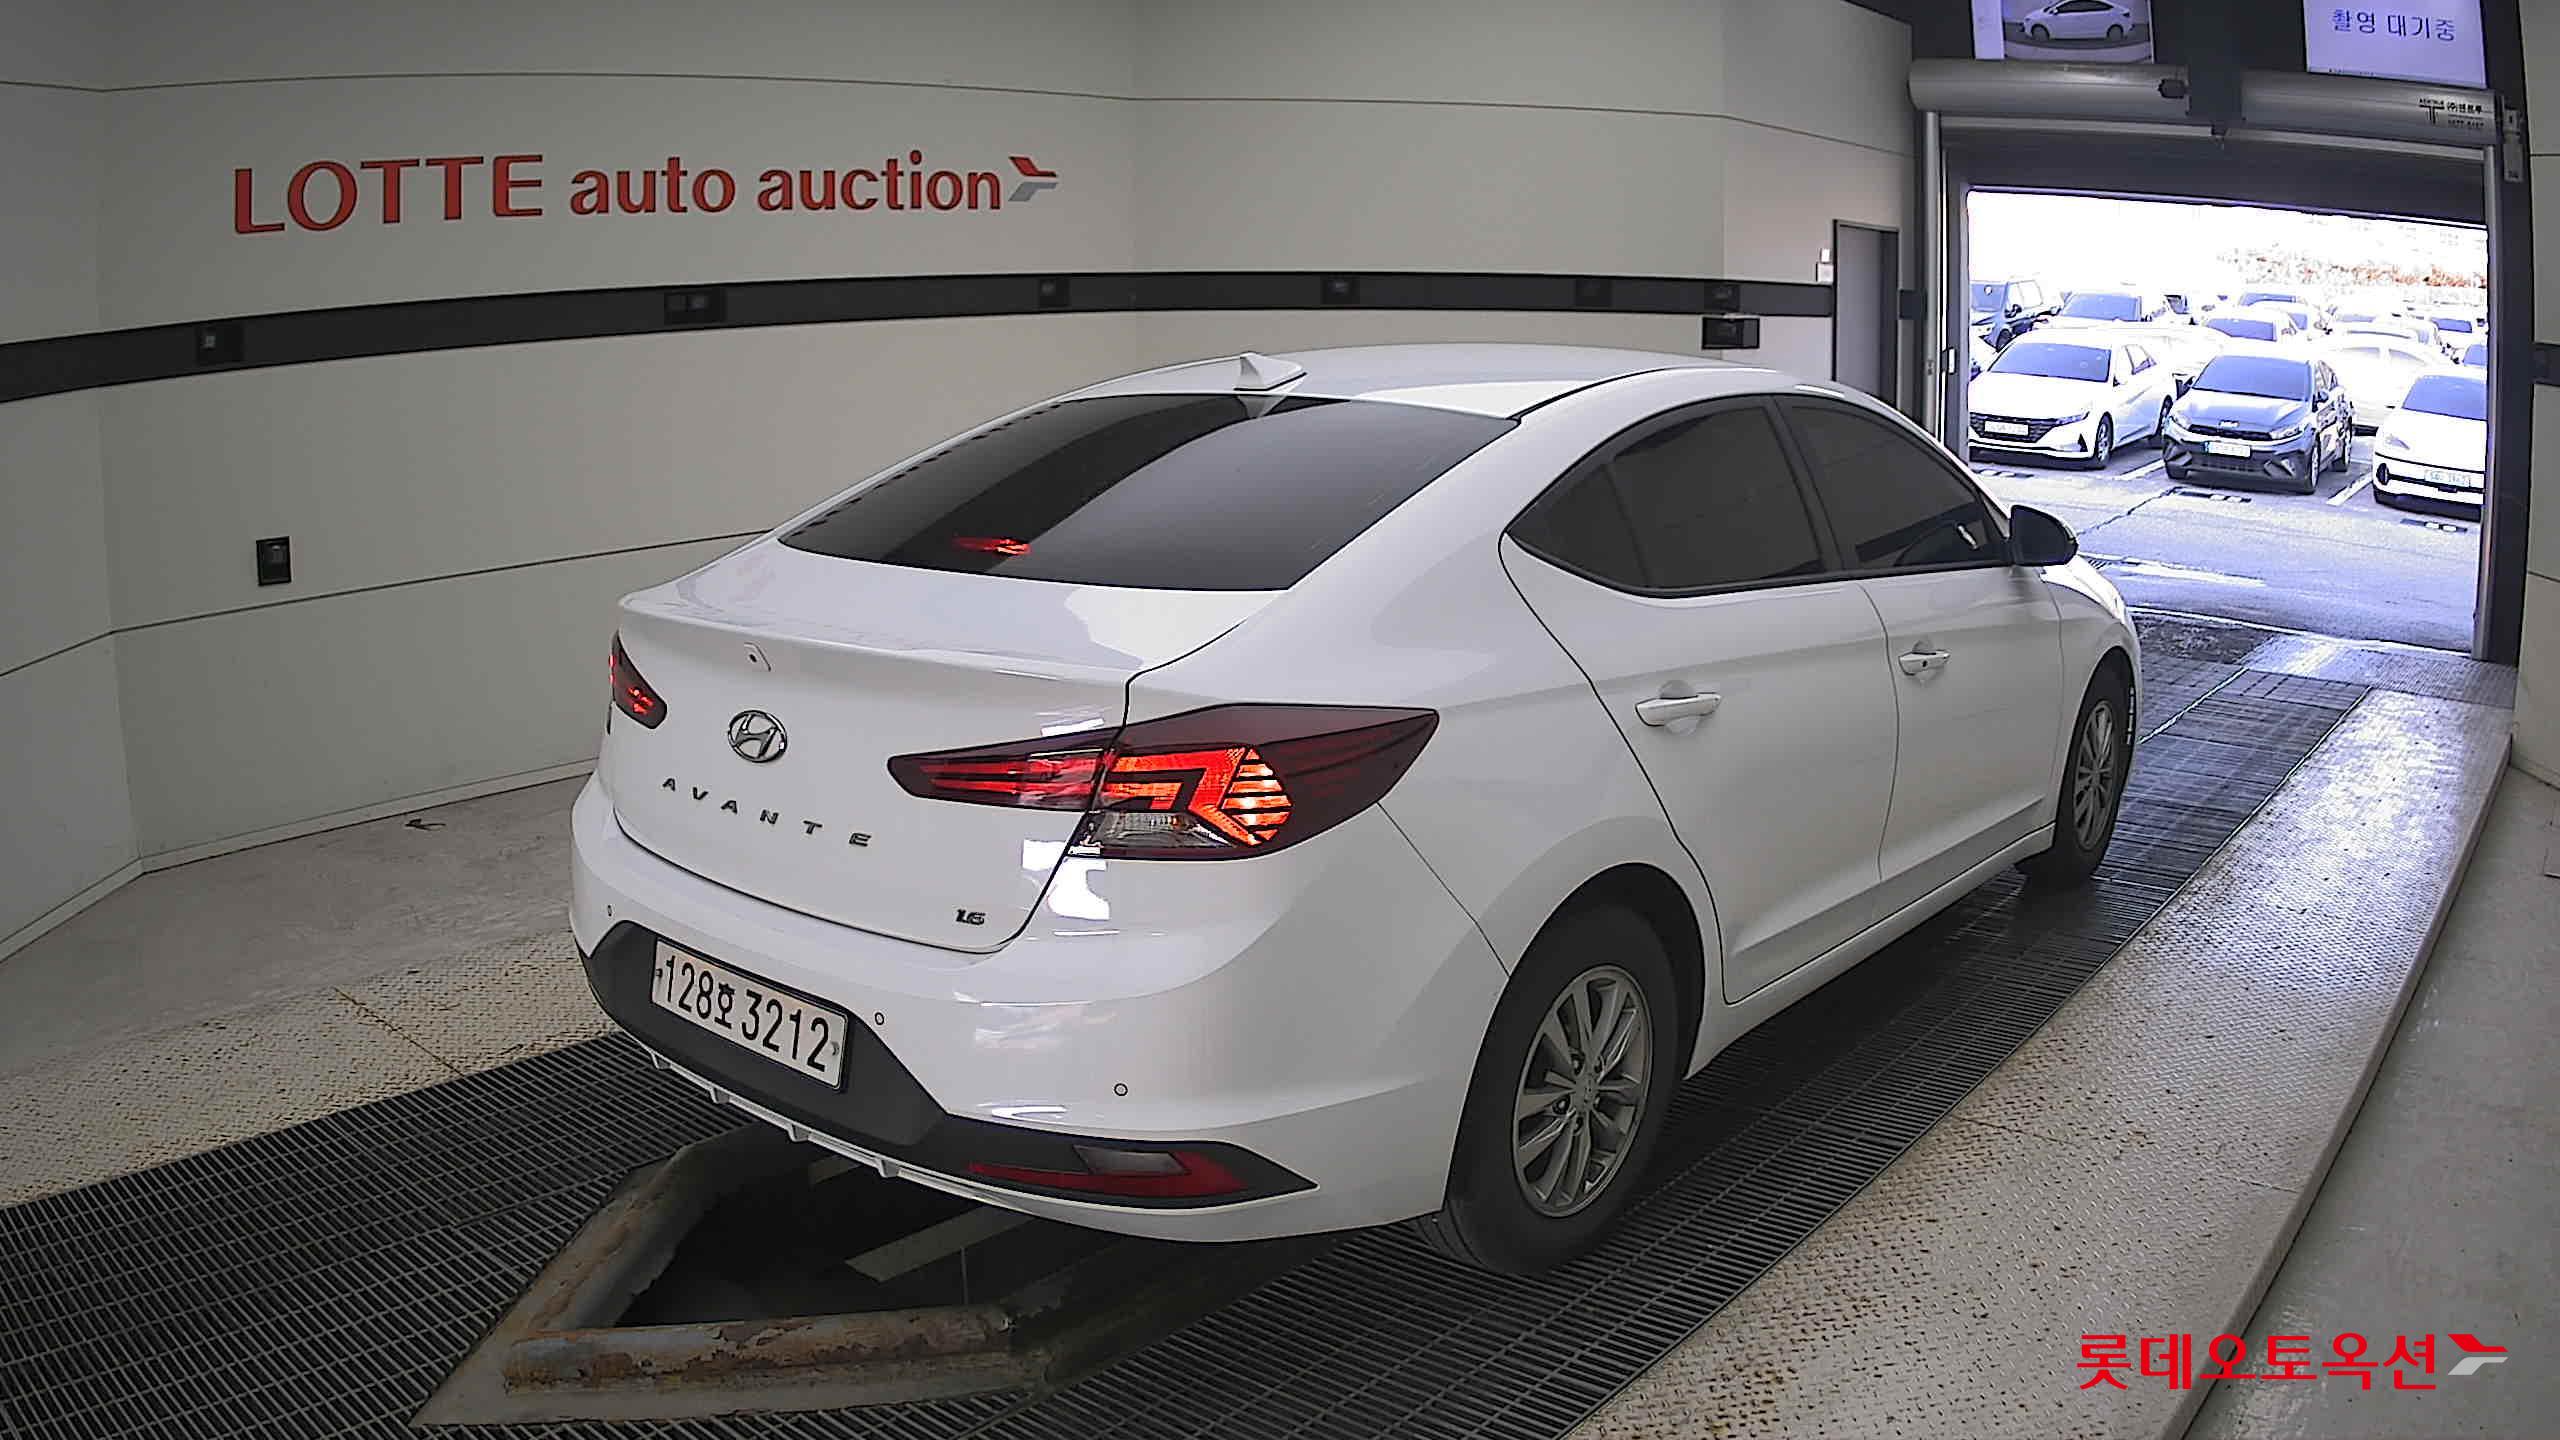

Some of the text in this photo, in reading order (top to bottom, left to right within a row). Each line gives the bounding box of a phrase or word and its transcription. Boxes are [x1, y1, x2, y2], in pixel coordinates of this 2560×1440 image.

[2387, 14, 2456, 42] 대기중
[234, 150, 1001, 234] LOTTE auto auction
[662, 777, 871, 847] AVANTE
